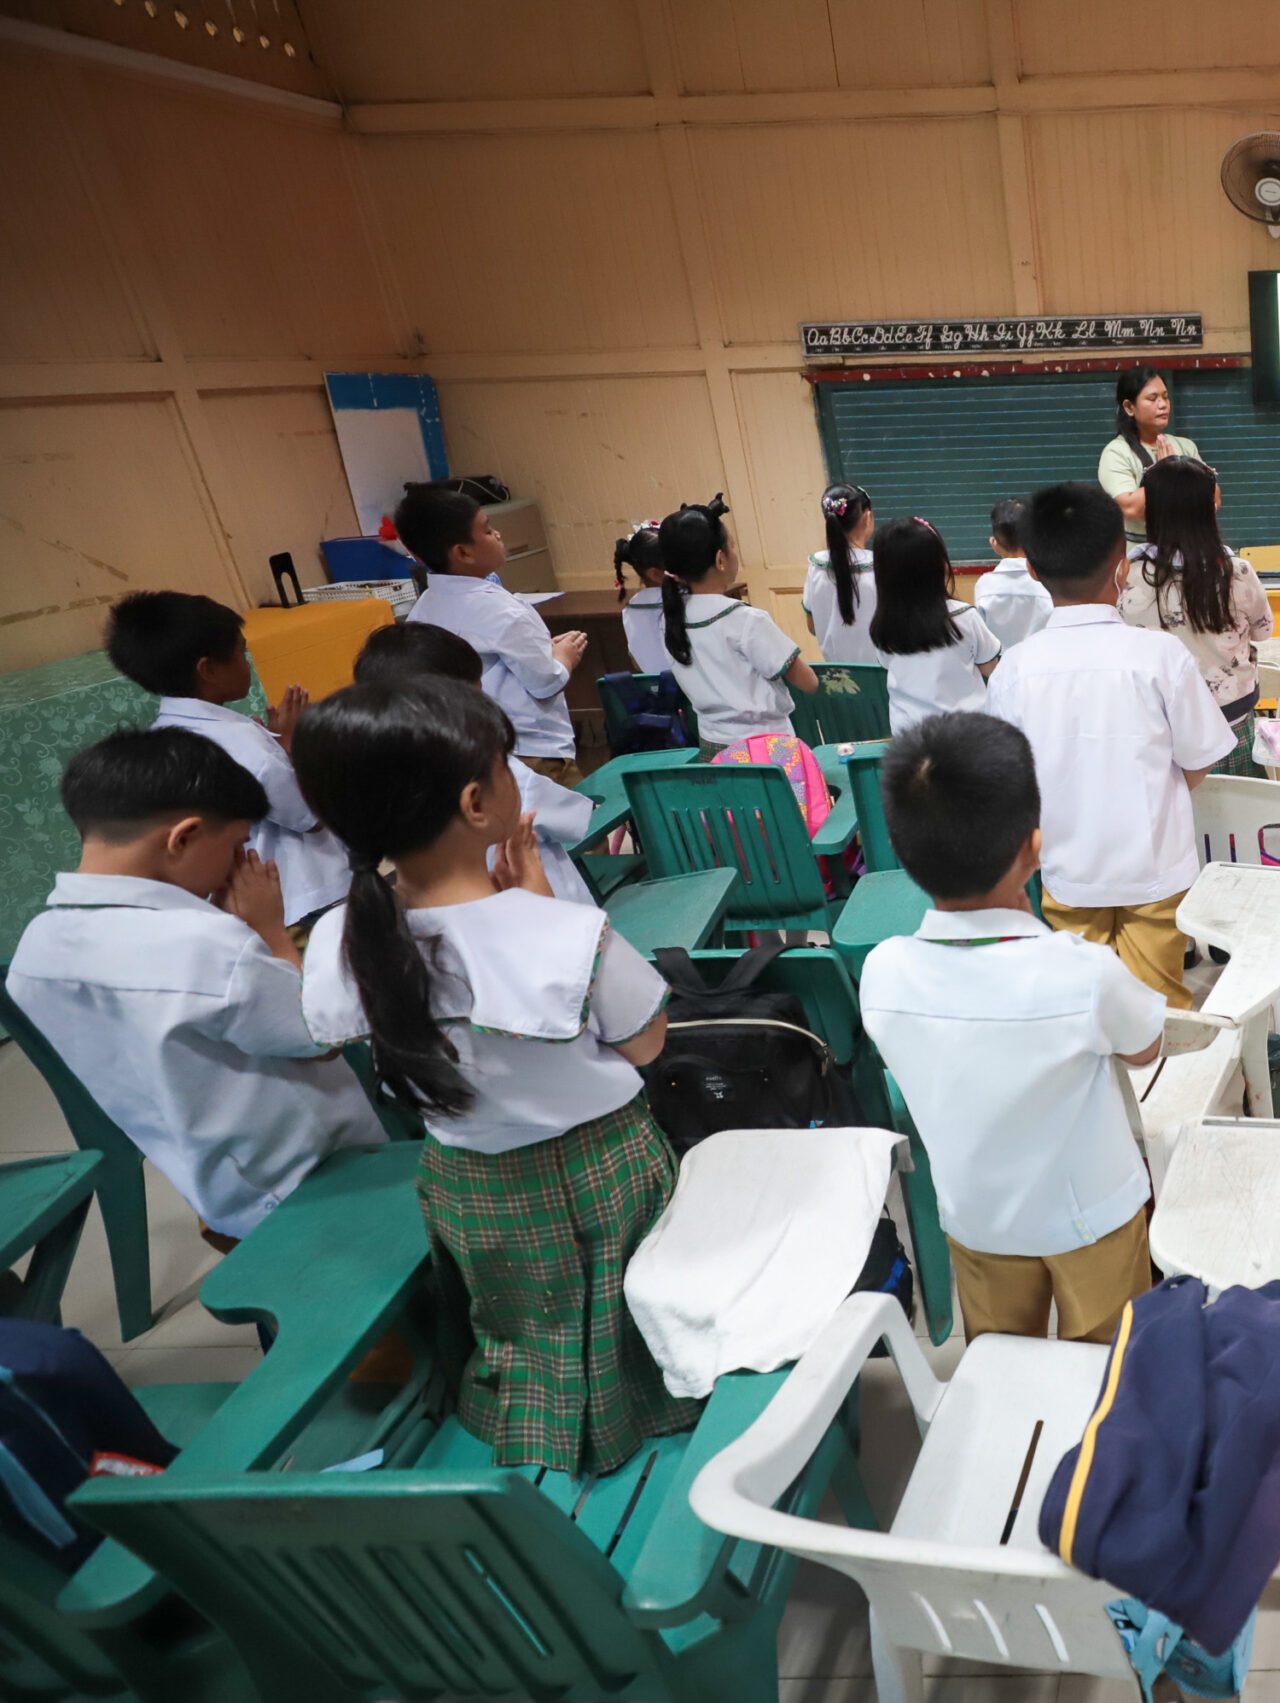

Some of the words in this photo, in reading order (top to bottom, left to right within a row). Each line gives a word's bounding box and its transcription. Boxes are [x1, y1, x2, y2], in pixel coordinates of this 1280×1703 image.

[807, 327, 829, 346] Aa
[829, 327, 851, 345] Bb
[851, 326, 869, 345] Cc
[869, 326, 895, 344] Dd
[894, 326, 913, 344] Ee
[1104, 320, 1135, 338] Mm
[1139, 319, 1165, 337] Nn
